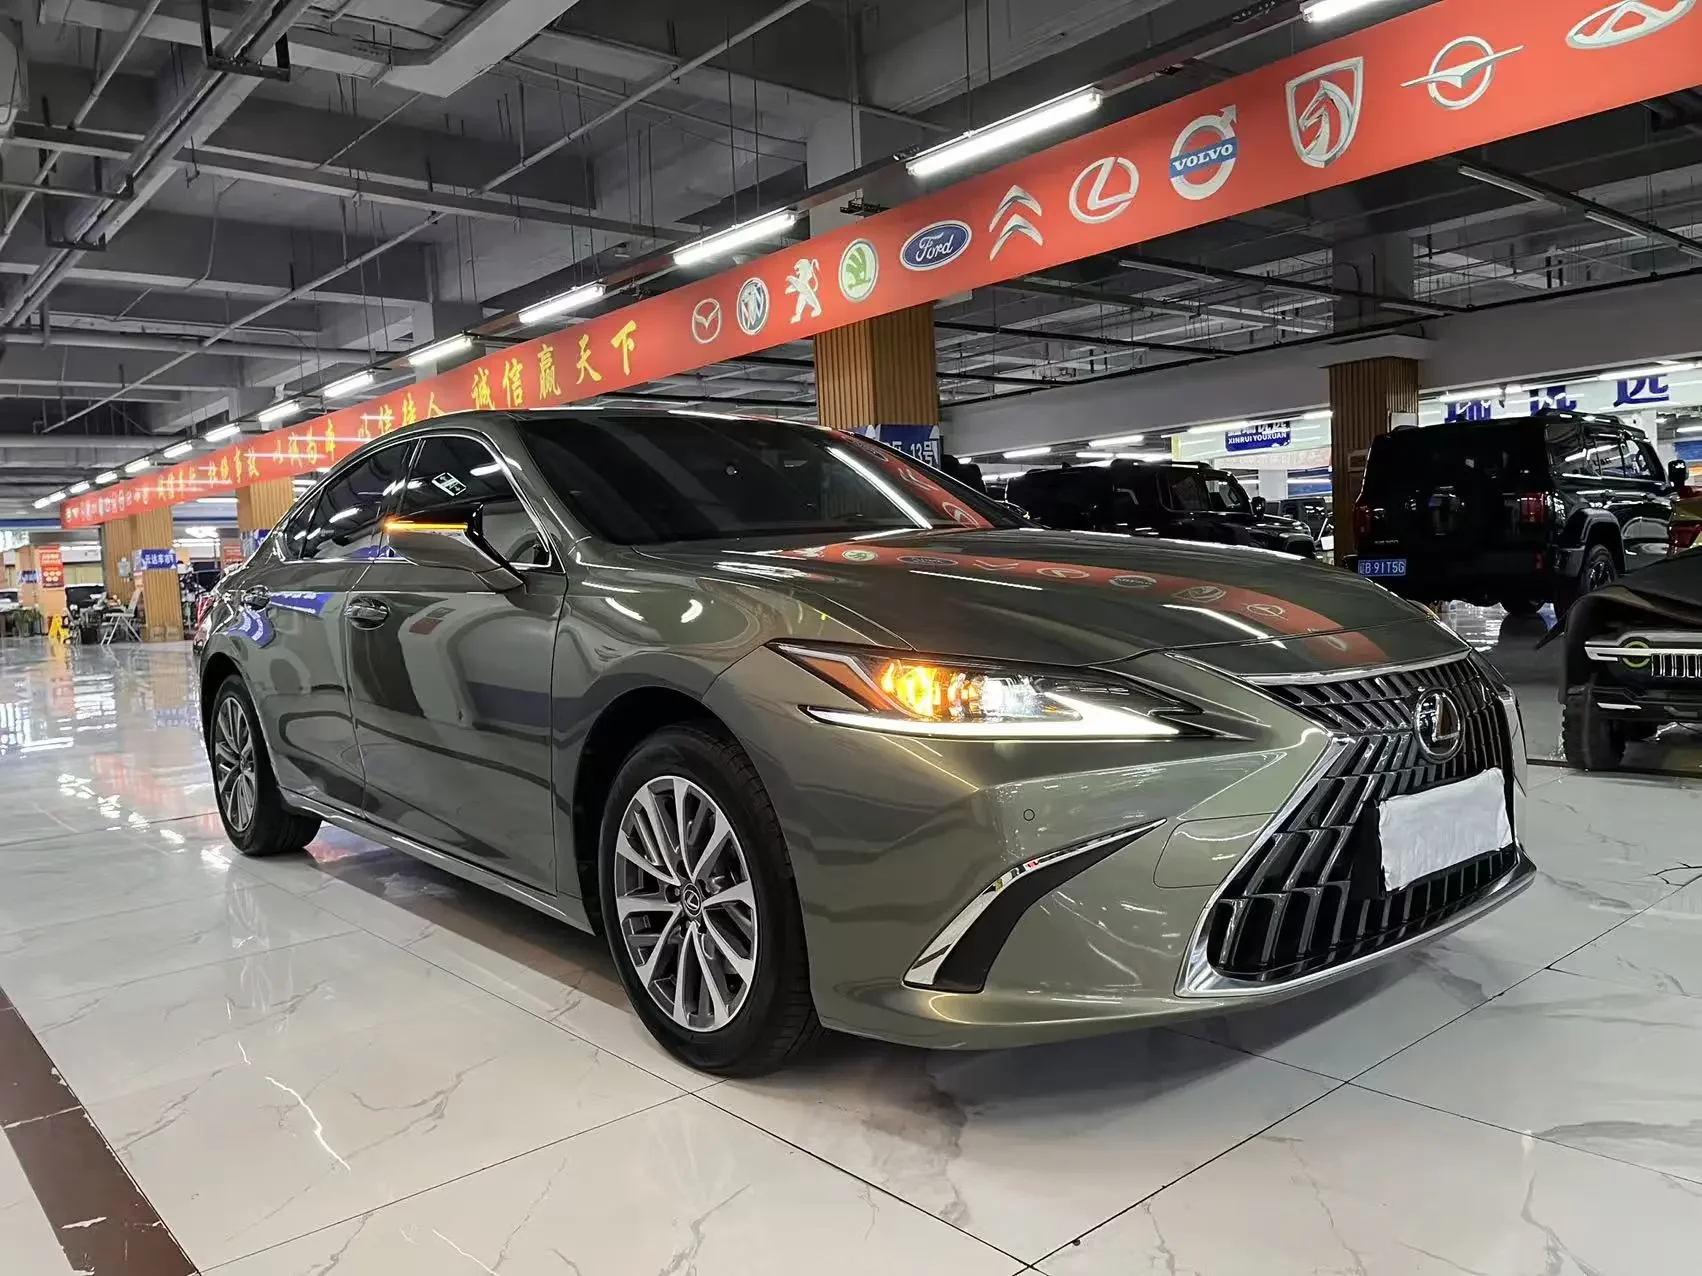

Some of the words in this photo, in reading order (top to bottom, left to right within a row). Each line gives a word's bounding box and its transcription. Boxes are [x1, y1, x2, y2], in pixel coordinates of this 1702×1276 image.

[1172, 144, 1233, 171] VOLVO
[915, 231, 955, 262] Ford
[471, 319, 638, 410] 诚信赢天下
[1228, 434, 1253, 445] XINRUI
[1253, 432, 1287, 442] YOUXUAN
